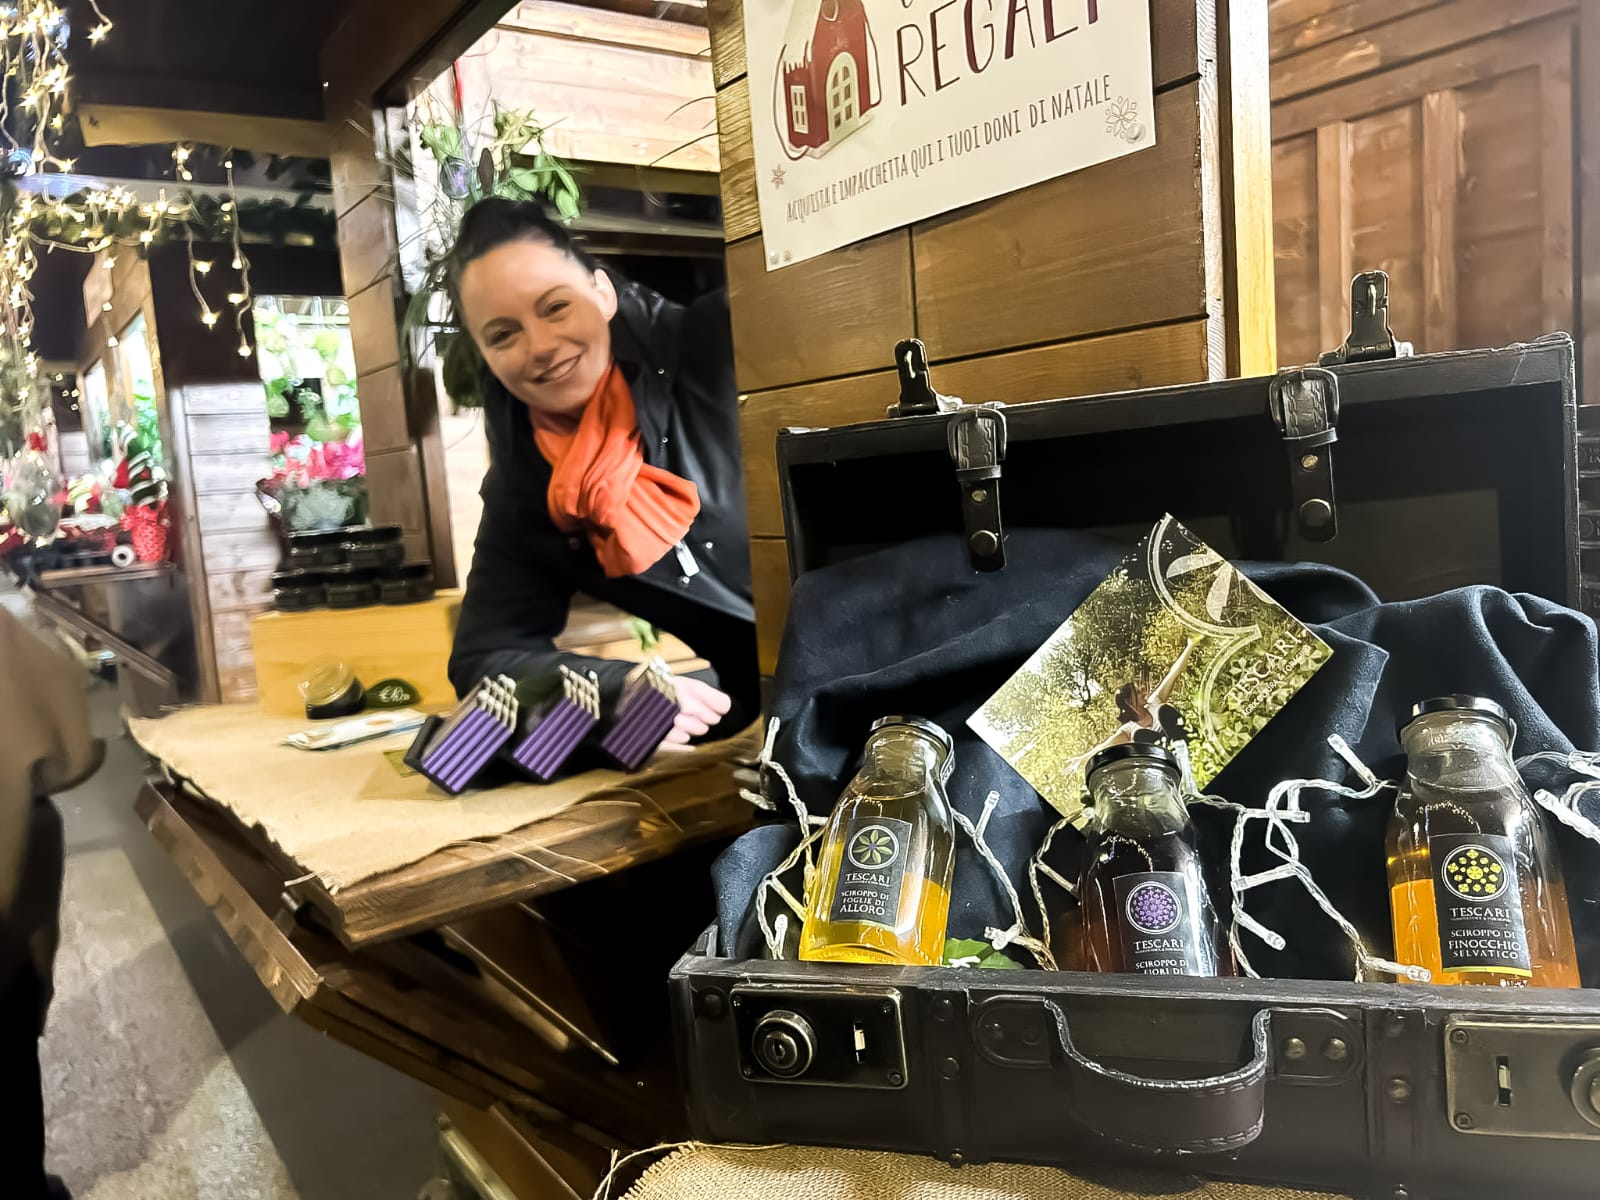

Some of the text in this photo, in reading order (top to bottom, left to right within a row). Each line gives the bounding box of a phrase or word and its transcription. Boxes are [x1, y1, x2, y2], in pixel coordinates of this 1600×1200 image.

[786, 74, 1112, 223] ACQUISTA E IMPACCHETTA QUI I TUOI DONI DI NATALE
[1222, 630, 1302, 705] TESCARI
[845, 872, 890, 884] TESCARI
[841, 890, 889, 901] SCIROPPO DI
[874, 899, 885, 907] DI
[840, 904, 885, 915] ALLORO
[1449, 906, 1510, 918] TESCARI
[1451, 929, 1515, 939] SCIROPPO DI
[1133, 938, 1184, 951] TESCARI
[1448, 939, 1521, 951] FINOCCHIO
[1453, 949, 1518, 959] SELVATICO
[1135, 959, 1177, 969] SCIROPPO
[1173, 967, 1184, 975] DI
